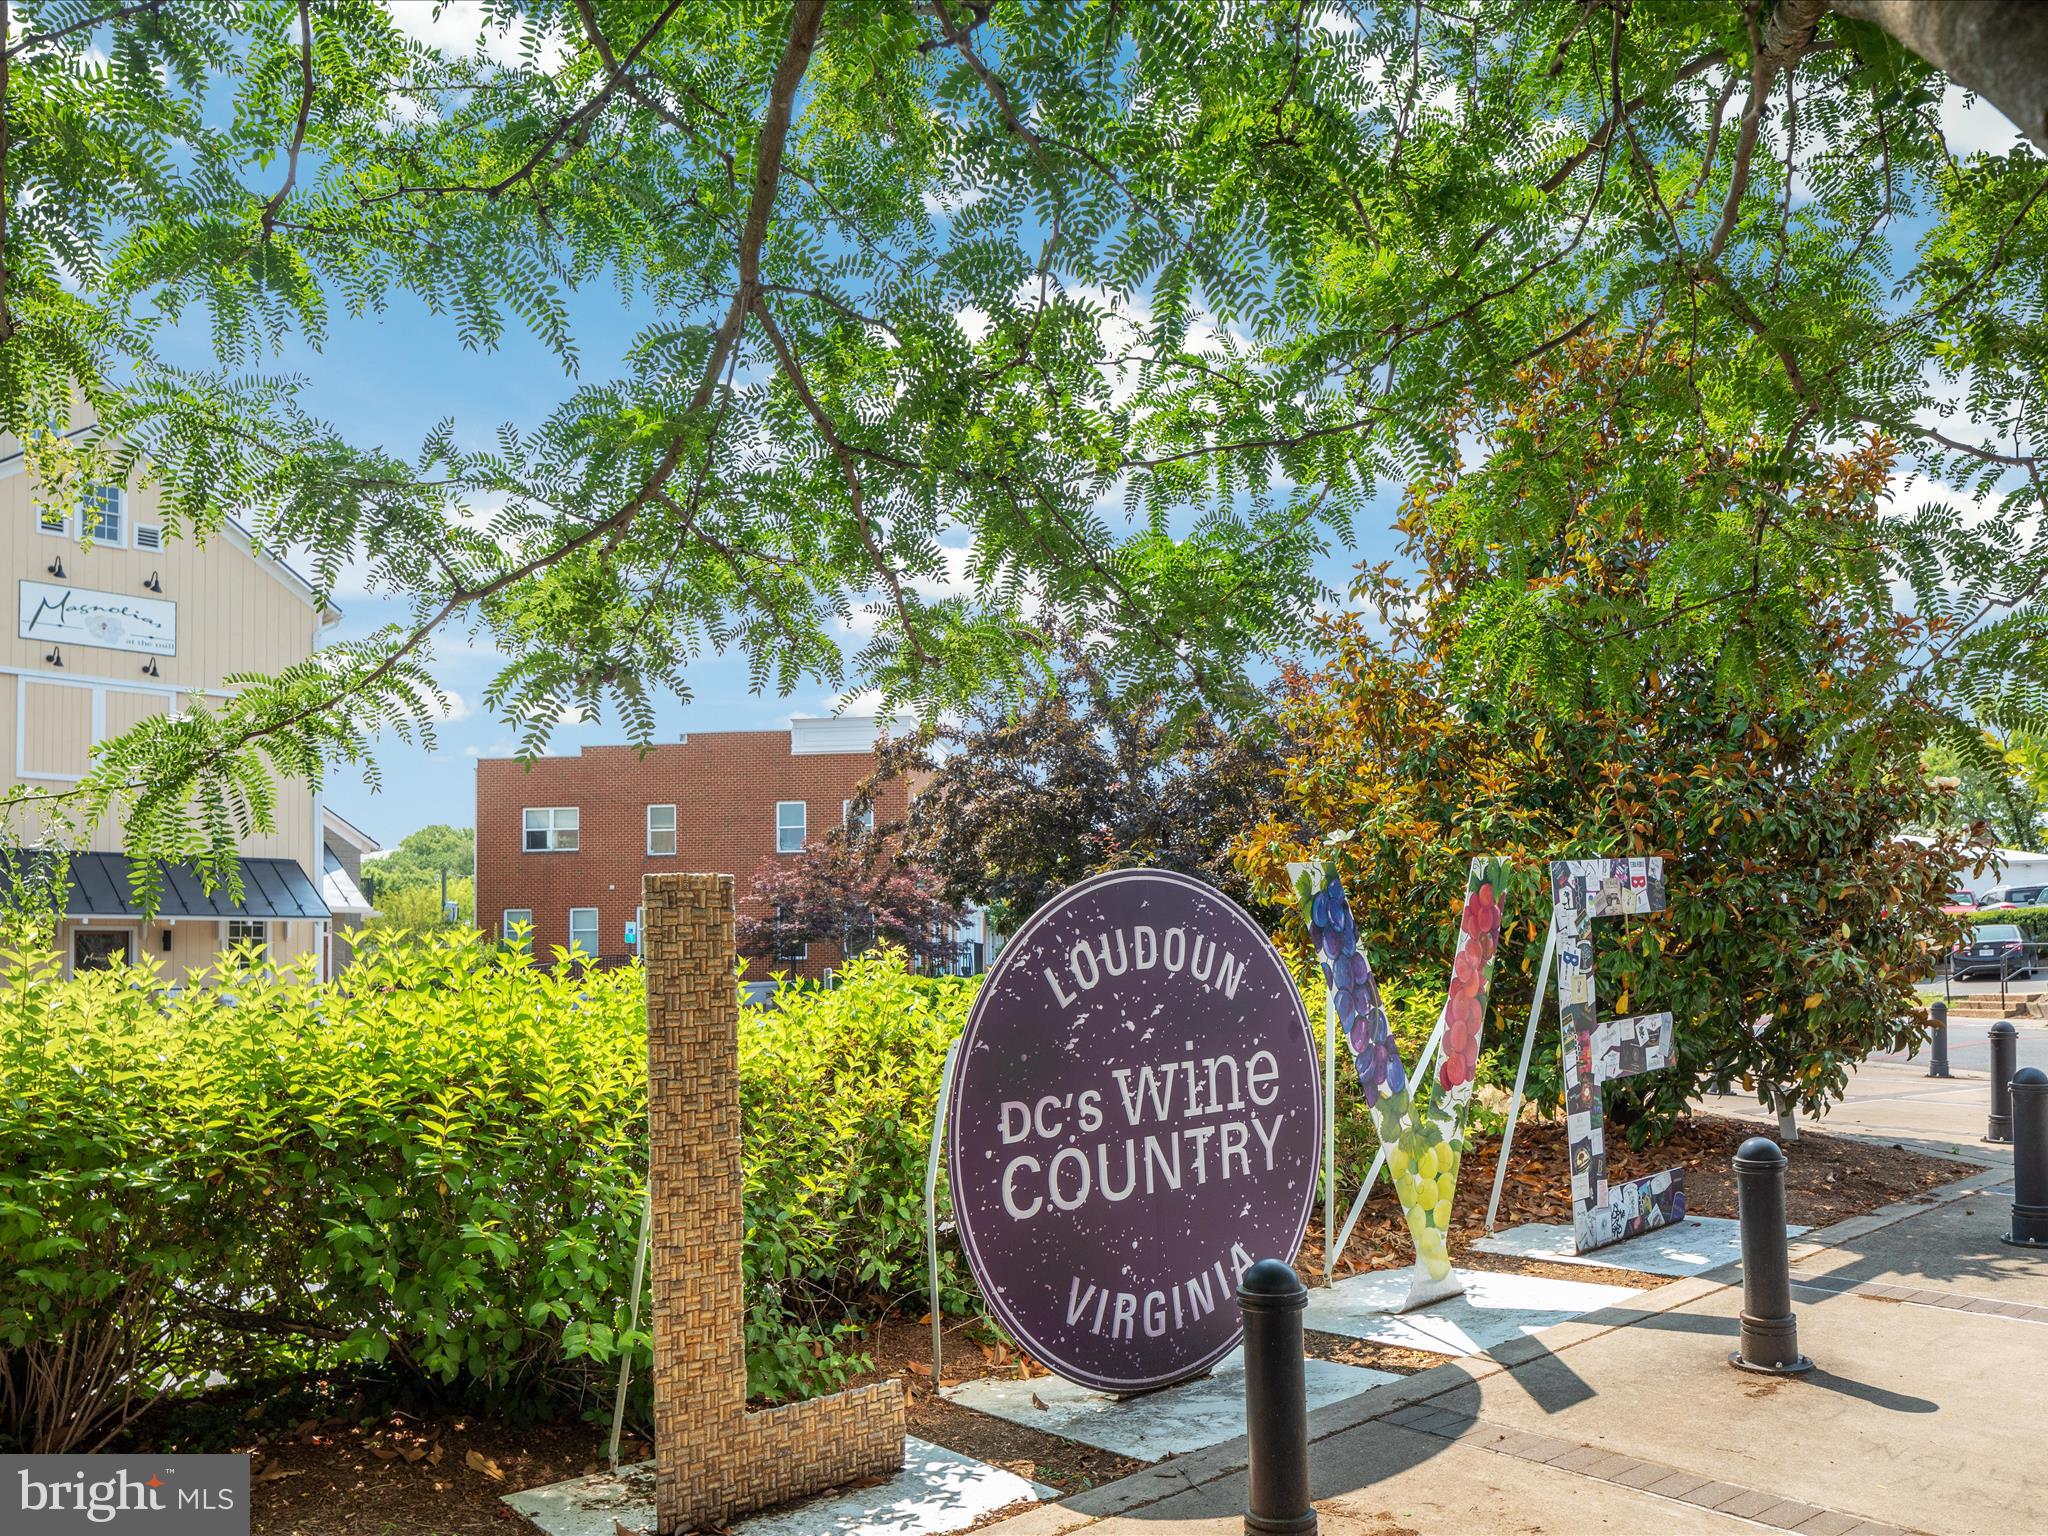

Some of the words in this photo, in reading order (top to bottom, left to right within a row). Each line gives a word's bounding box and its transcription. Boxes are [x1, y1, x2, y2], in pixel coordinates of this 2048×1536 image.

[28, 590, 161, 631] Magnolias
[137, 638, 153, 647] the
[155, 640, 175, 650] mill
[1043, 925, 1245, 1009] LOUDOUN
[1111, 1040, 1280, 1126] Wine
[1001, 1114, 1285, 1220] COUNTRY
[1065, 1240, 1254, 1339] VIRGINIA
